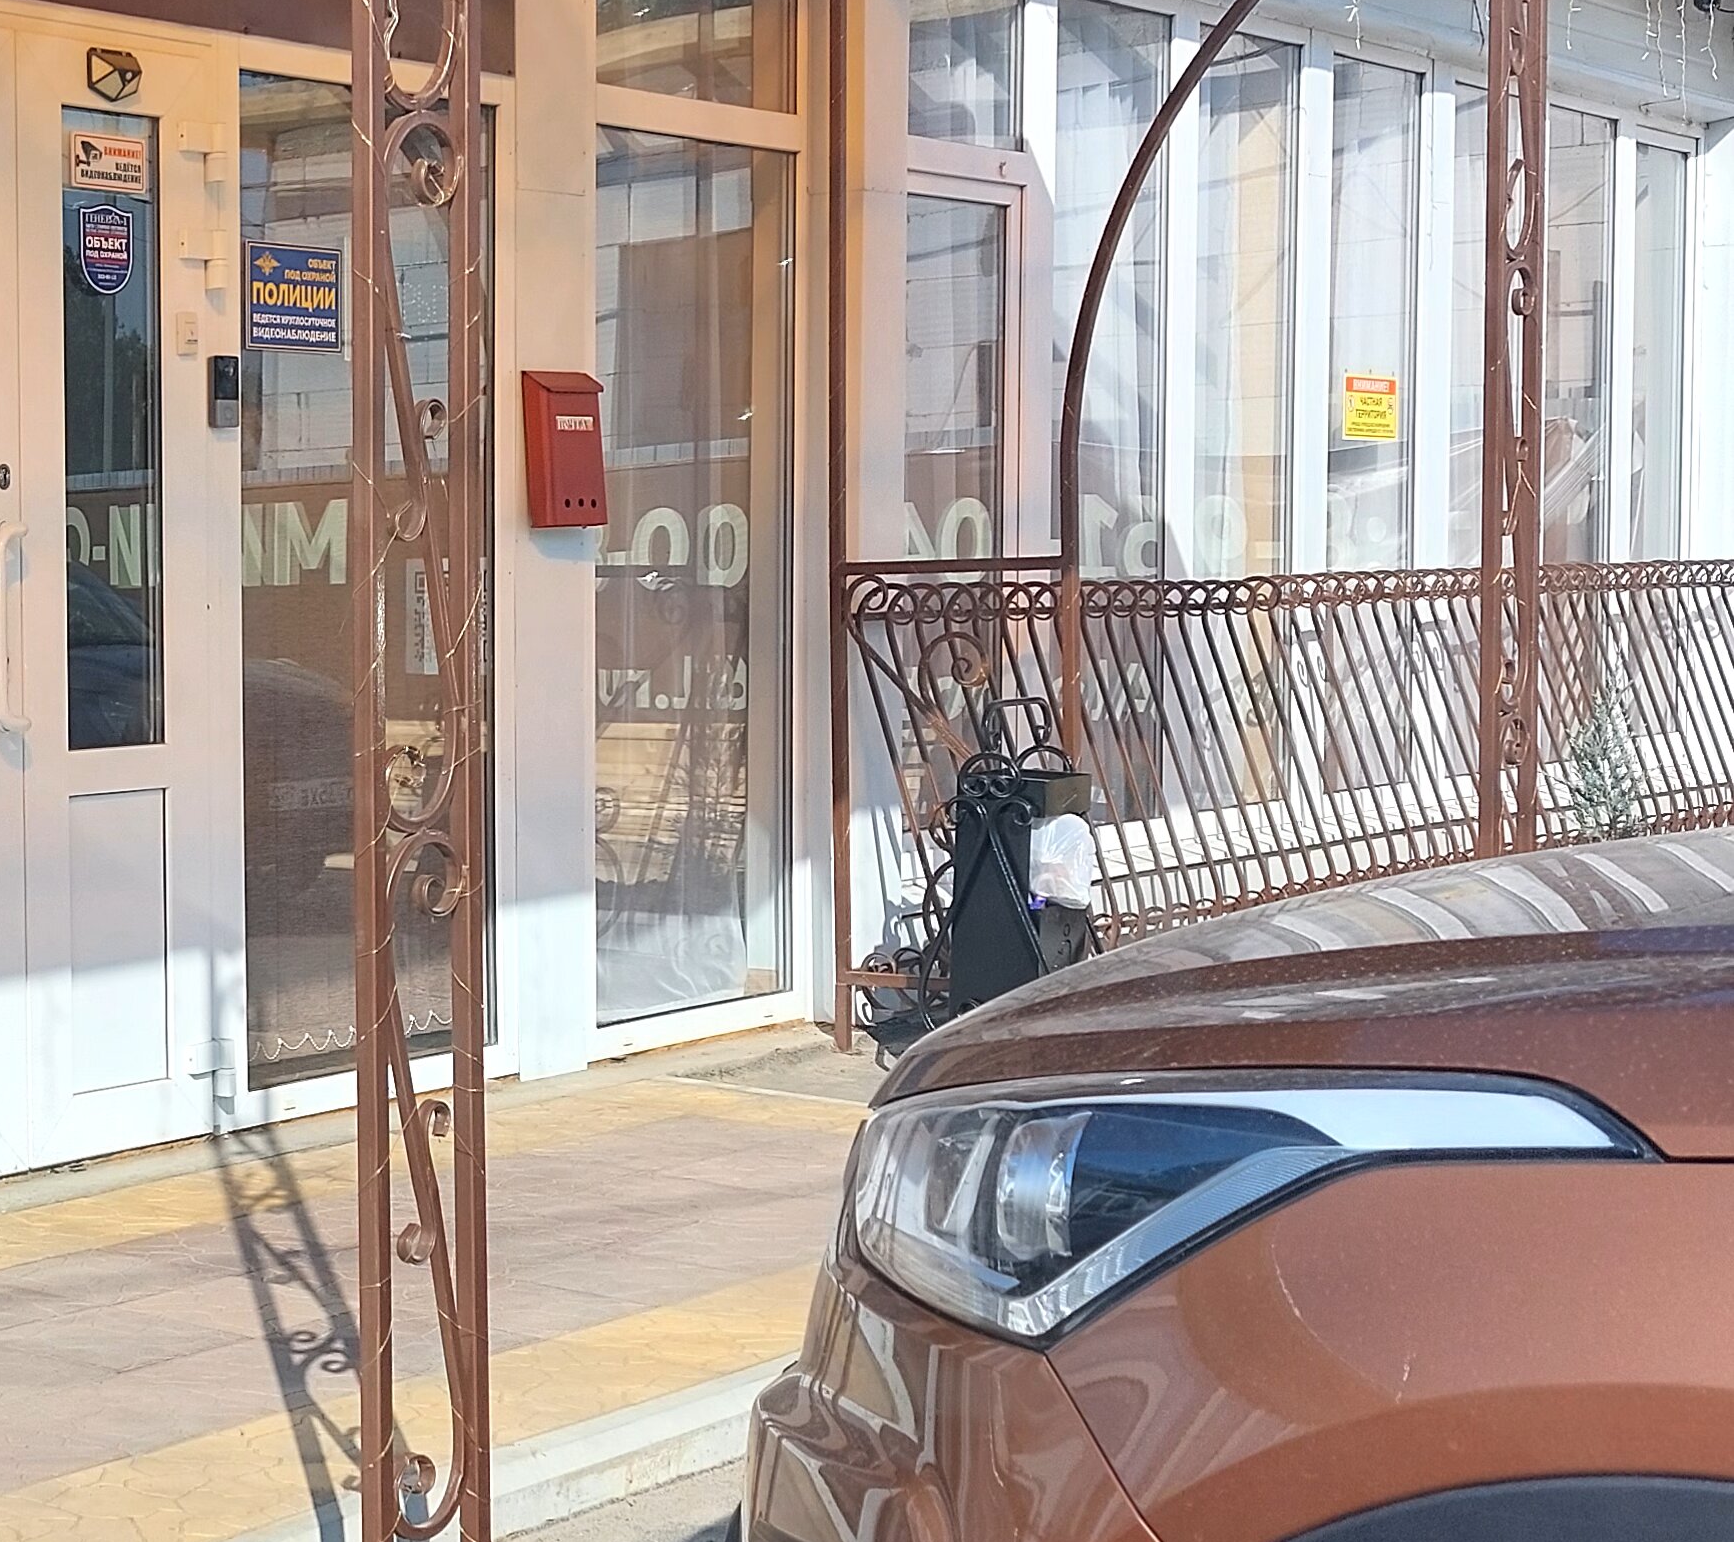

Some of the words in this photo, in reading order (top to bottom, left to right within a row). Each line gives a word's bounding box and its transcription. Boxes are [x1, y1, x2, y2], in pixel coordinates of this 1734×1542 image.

[80, 169, 142, 185] ВИДЕОНАБЛЮДЕНИЕ
[85, 236, 128, 252] ОБЪЕКТ
[85, 249, 99, 259] ПОД
[100, 250, 128, 261] ОХРАНОЙ
[308, 258, 336, 270] ОБЪЕКТ
[285, 269, 301, 281] ПОД
[302, 270, 336, 283] ОХРАНОЙ
[252, 281, 336, 312] ПОЛИЦИИ
[281, 315, 336, 328] КРУГЛОСУТОЧНОЕ
[252, 327, 337, 342] ВИДЕОНАБЛЮДЕНИЕ
